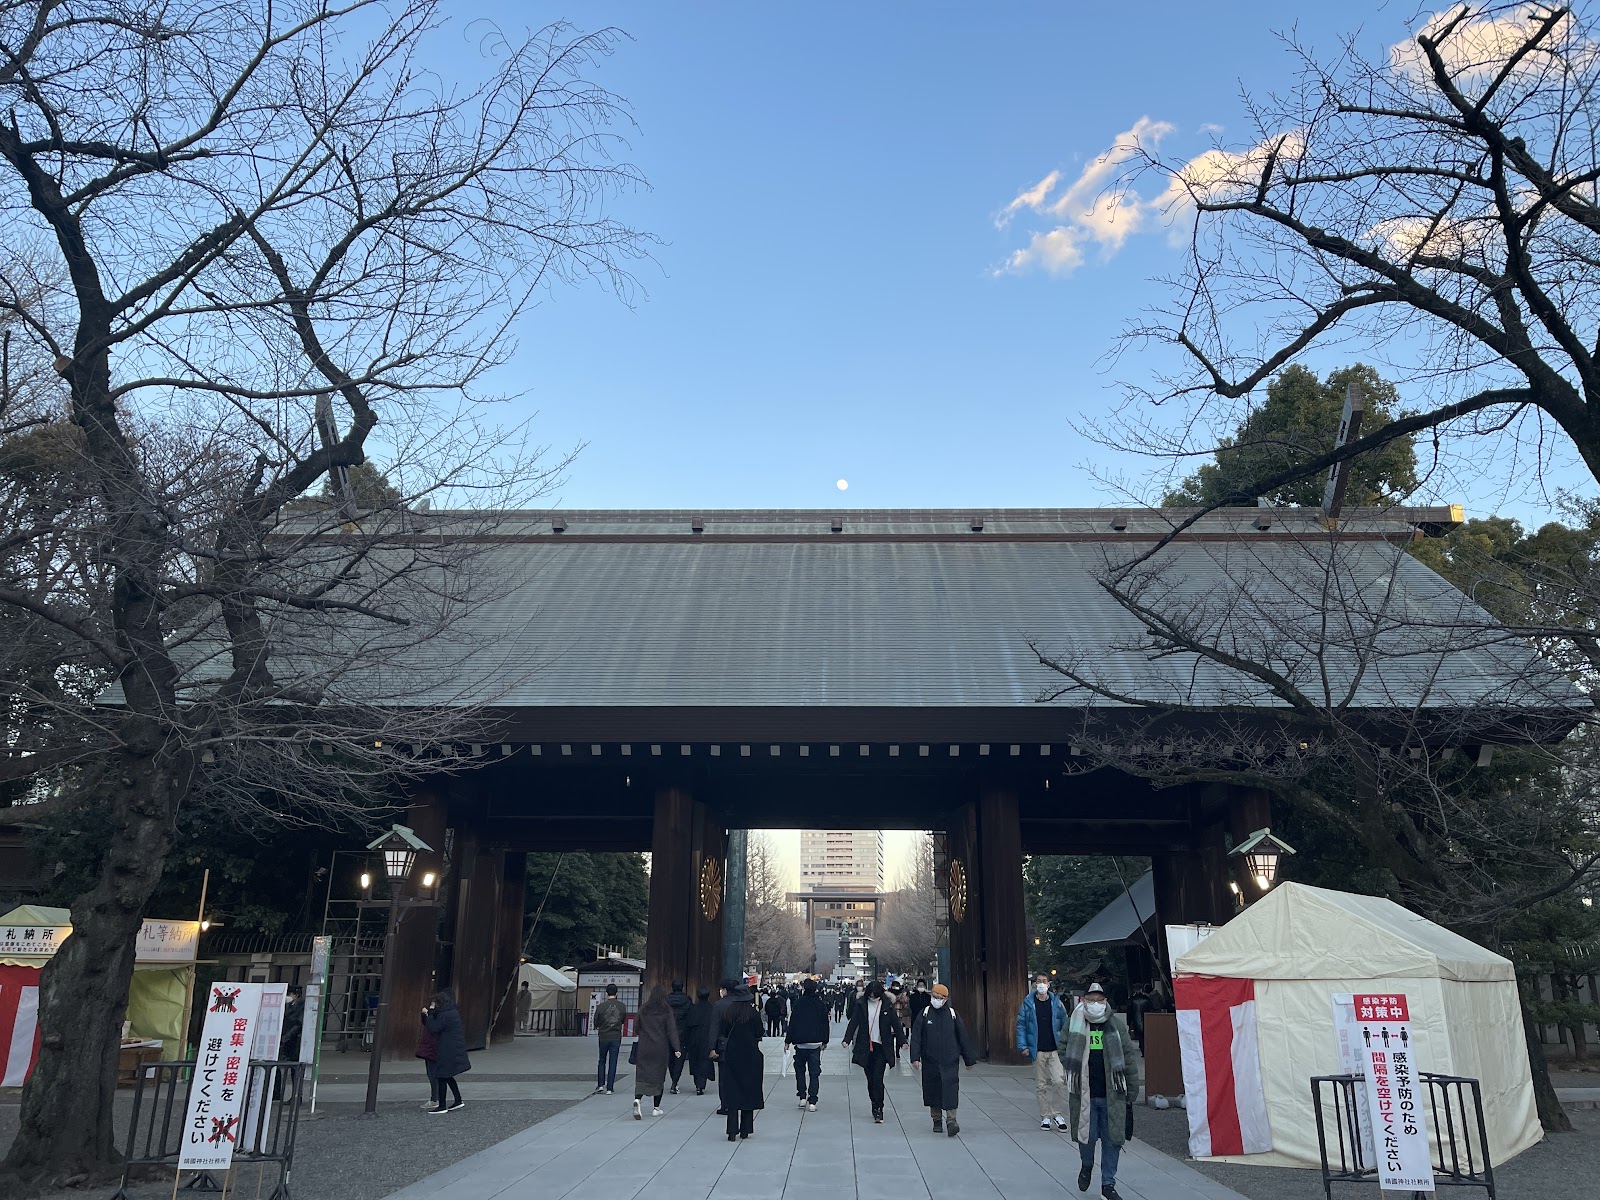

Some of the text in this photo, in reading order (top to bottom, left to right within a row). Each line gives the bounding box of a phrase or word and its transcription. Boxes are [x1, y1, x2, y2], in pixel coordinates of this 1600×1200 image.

[6, 928, 54, 940] 札納所
[138, 924, 195, 943] 札等納所
[1360, 1006, 1403, 1019] 対策中
[1362, 997, 1398, 1005] 感染予防
[220, 1018, 248, 1102] 密集・密接を
[191, 1037, 223, 1144] 避けてください
[1371, 1051, 1402, 1172] 間隔を空けてください
[1392, 1051, 1418, 1136] 感染予防のため
